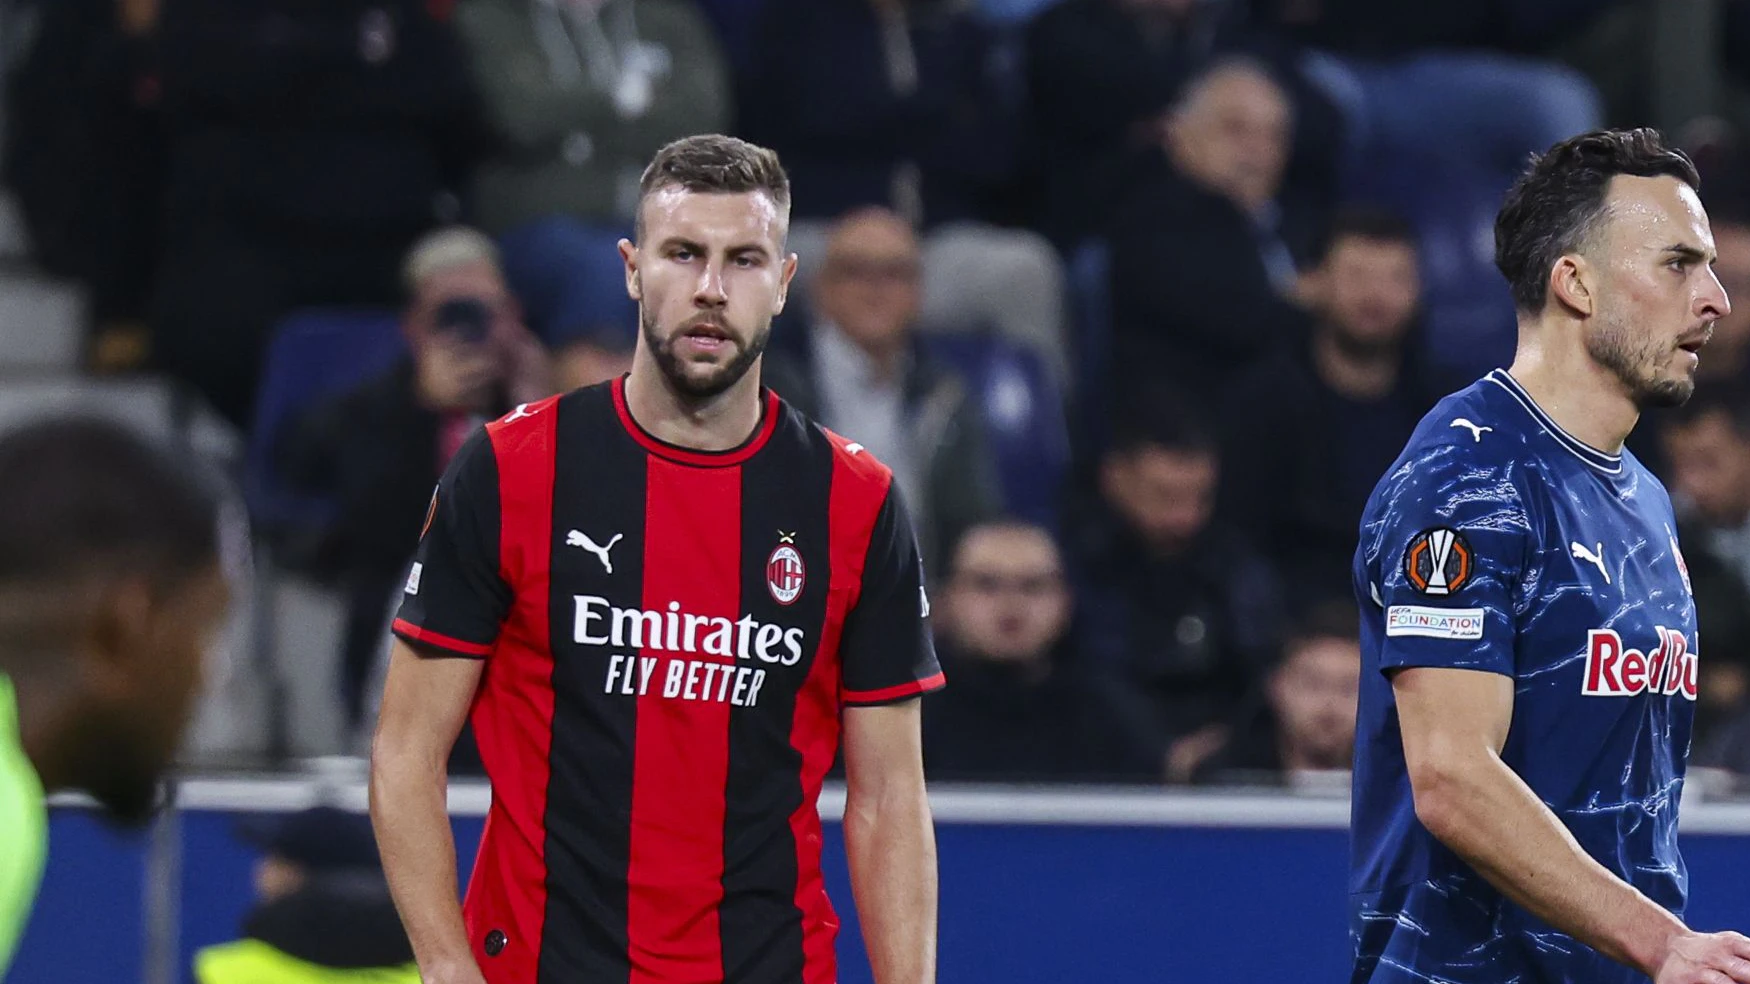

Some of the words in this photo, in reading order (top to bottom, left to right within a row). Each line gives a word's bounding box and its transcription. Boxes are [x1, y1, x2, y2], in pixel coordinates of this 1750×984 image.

[573, 594, 804, 666] Emirates
[1390, 615, 1480, 628] FOUNDATION
[604, 655, 657, 696] FLY
[663, 659, 766, 707] BETTER
